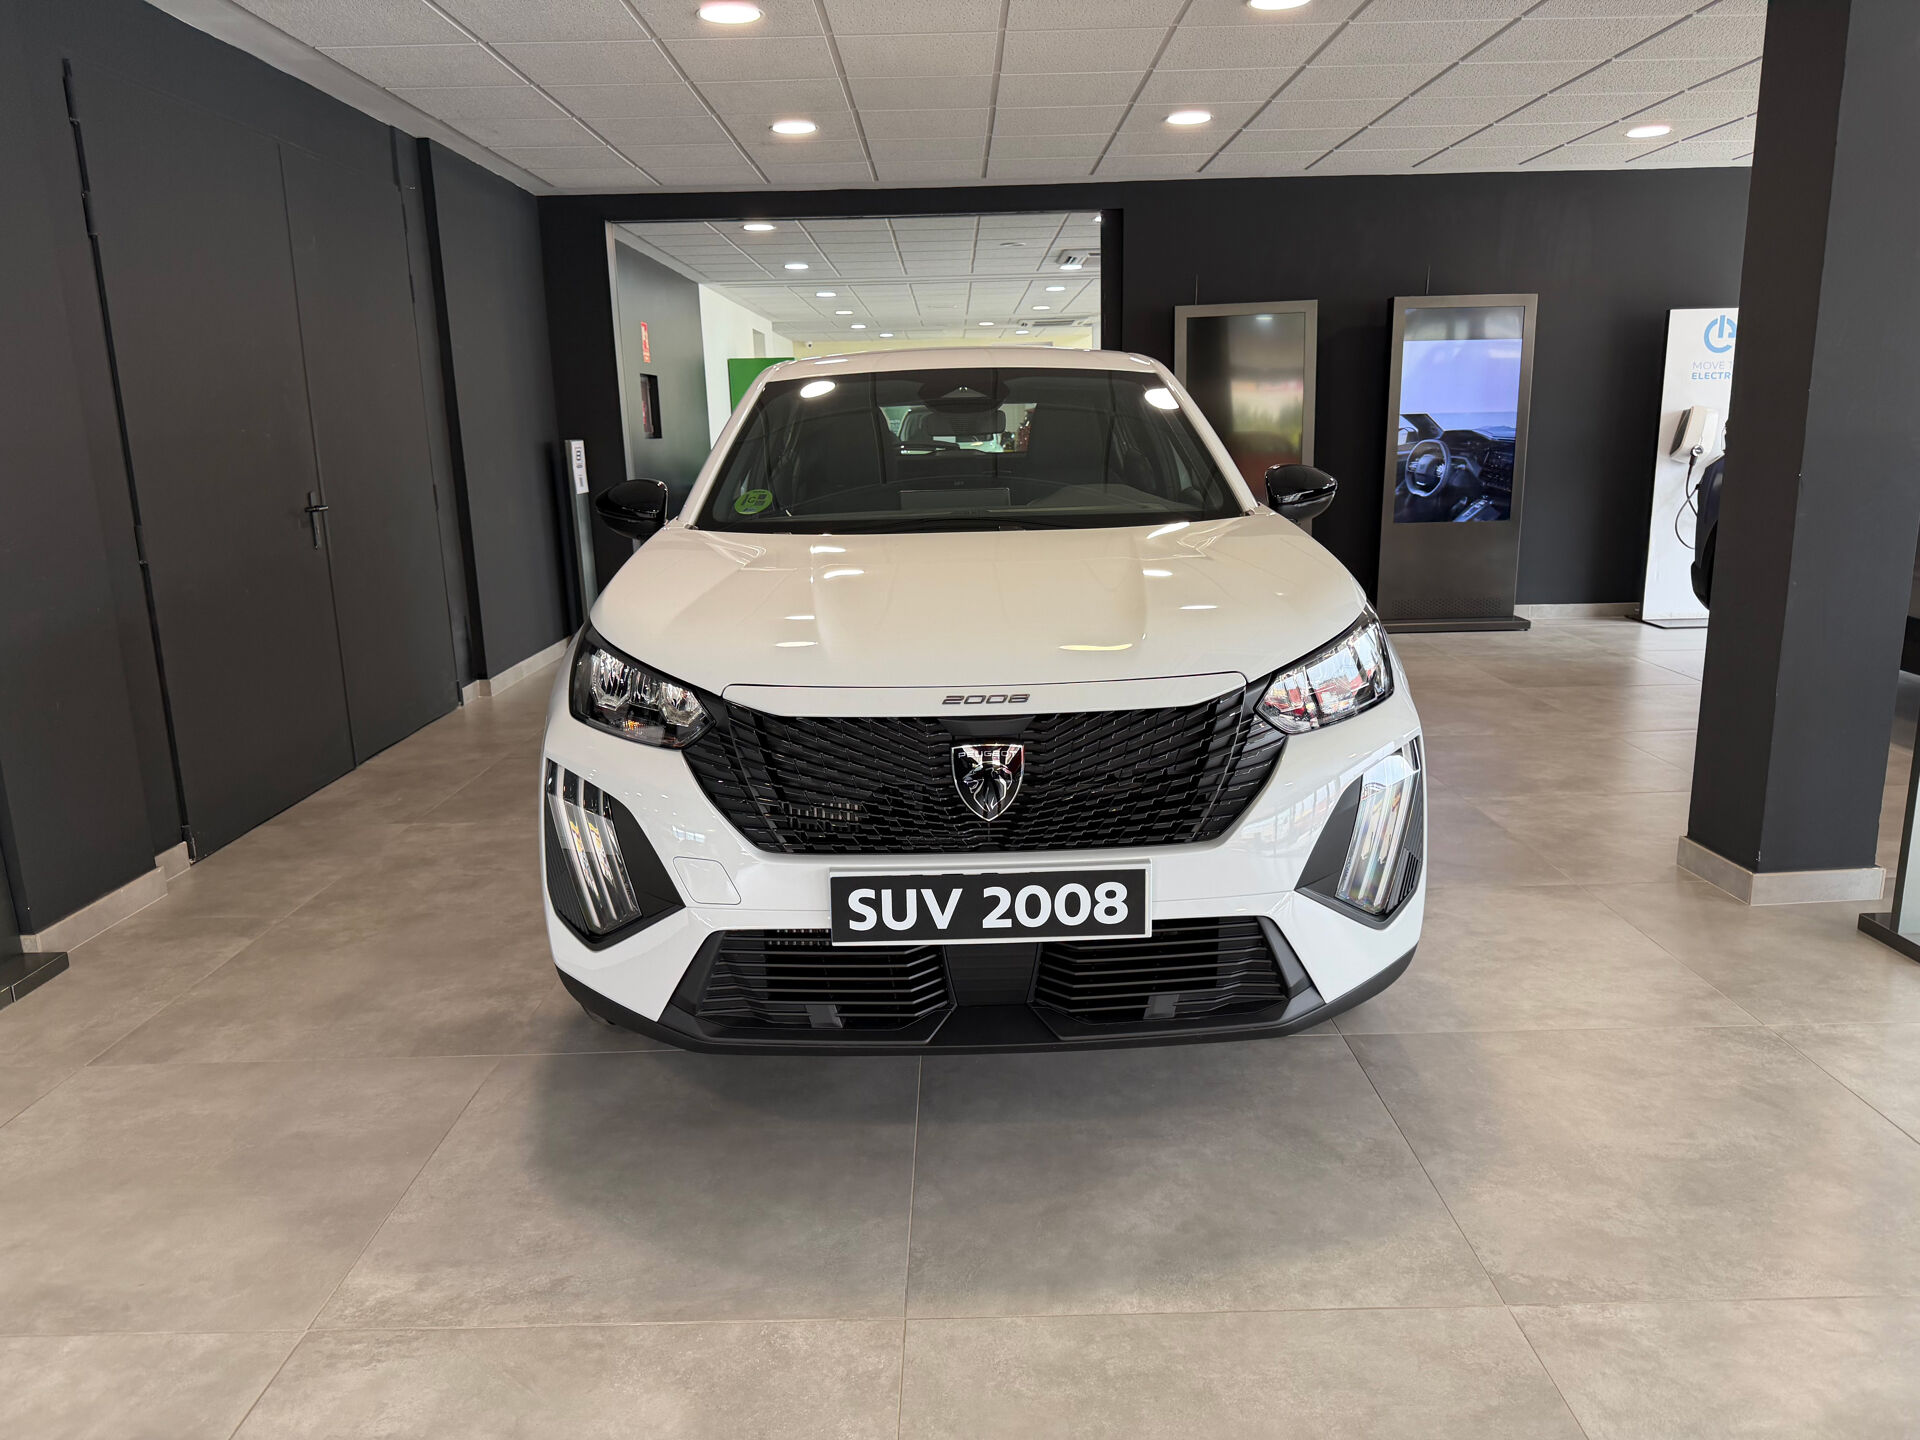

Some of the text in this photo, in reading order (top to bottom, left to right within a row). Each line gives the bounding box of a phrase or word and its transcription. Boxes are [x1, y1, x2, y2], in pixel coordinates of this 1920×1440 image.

[1692, 361, 1725, 370] MOVE
[1691, 371, 1731, 380] ELECTR
[942, 693, 1031, 705] 2008
[958, 750, 1018, 759] PEUGEOT
[848, 881, 1129, 931] SUV 2008
